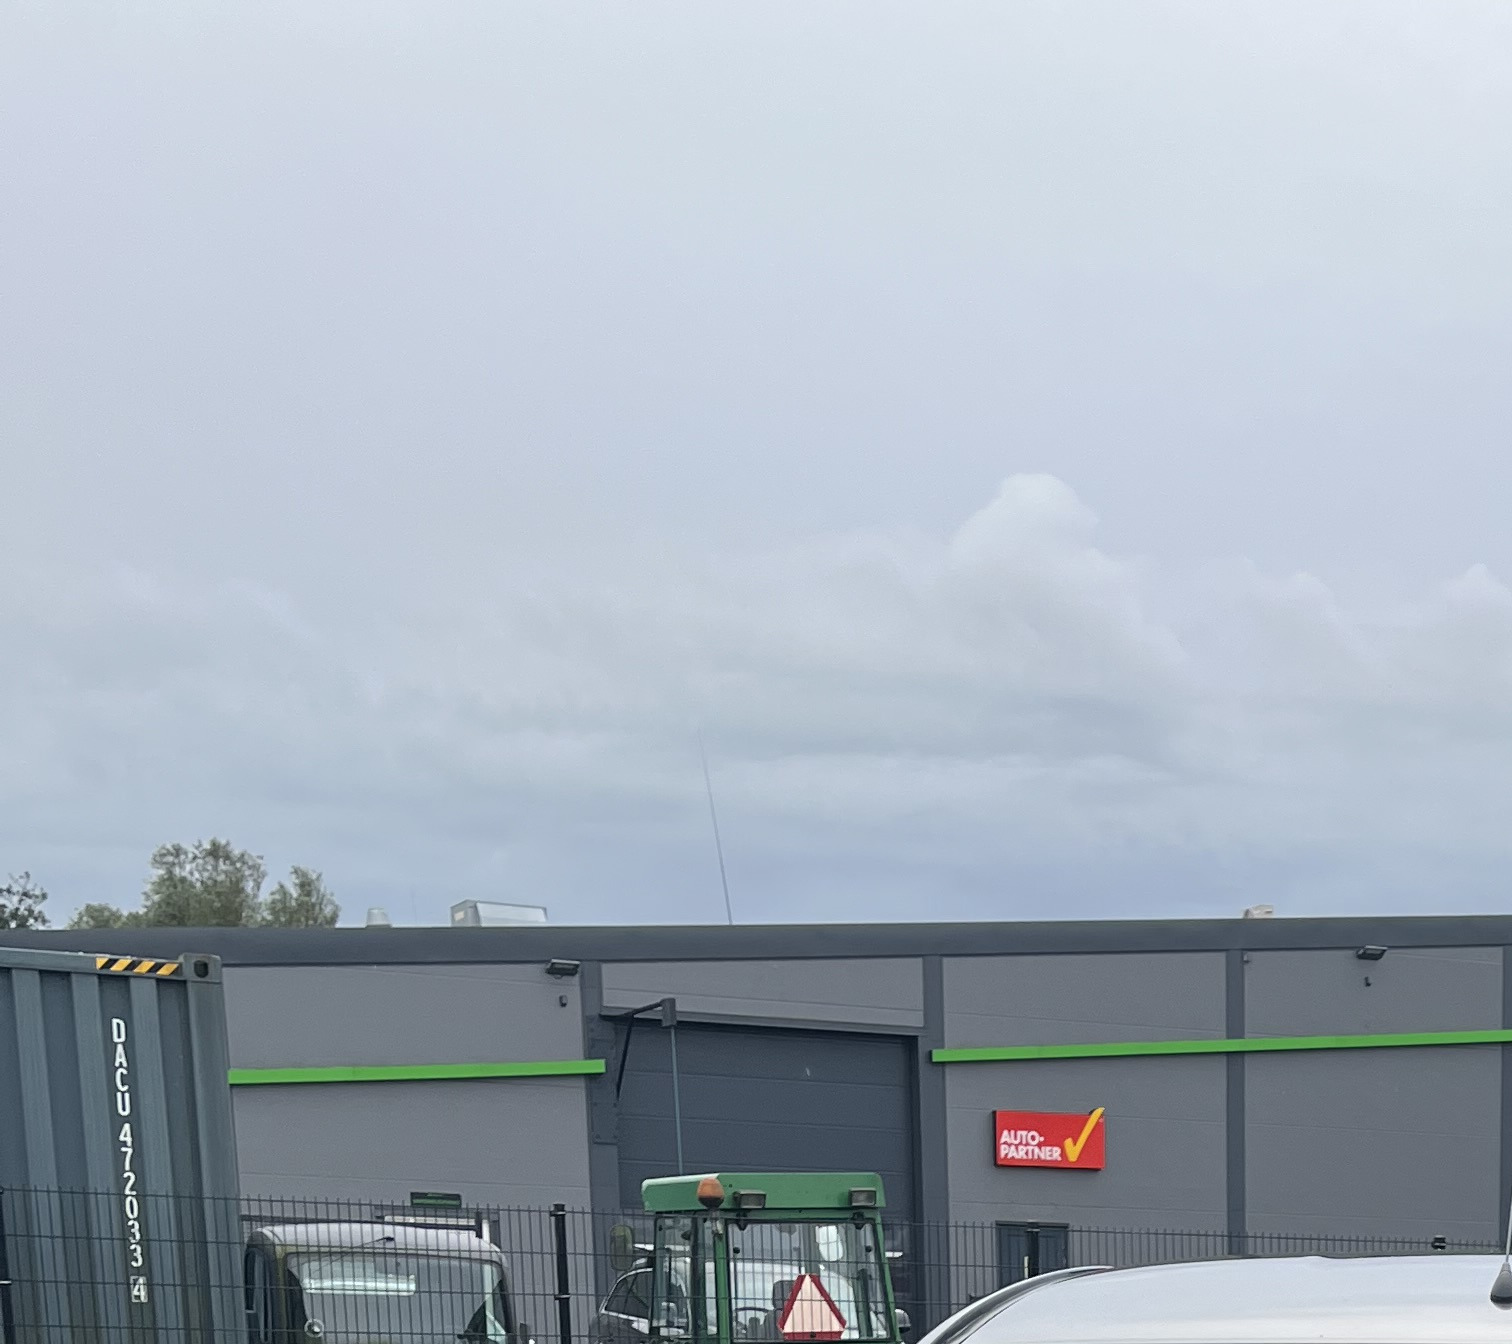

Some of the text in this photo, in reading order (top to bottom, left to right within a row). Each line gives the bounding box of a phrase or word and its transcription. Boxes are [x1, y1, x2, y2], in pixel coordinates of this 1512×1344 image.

[1000, 1129, 1044, 1145] AUTO-
[111, 1017, 147, 1302] DACU 472033 4
[1000, 1144, 1062, 1161] PARTNER
